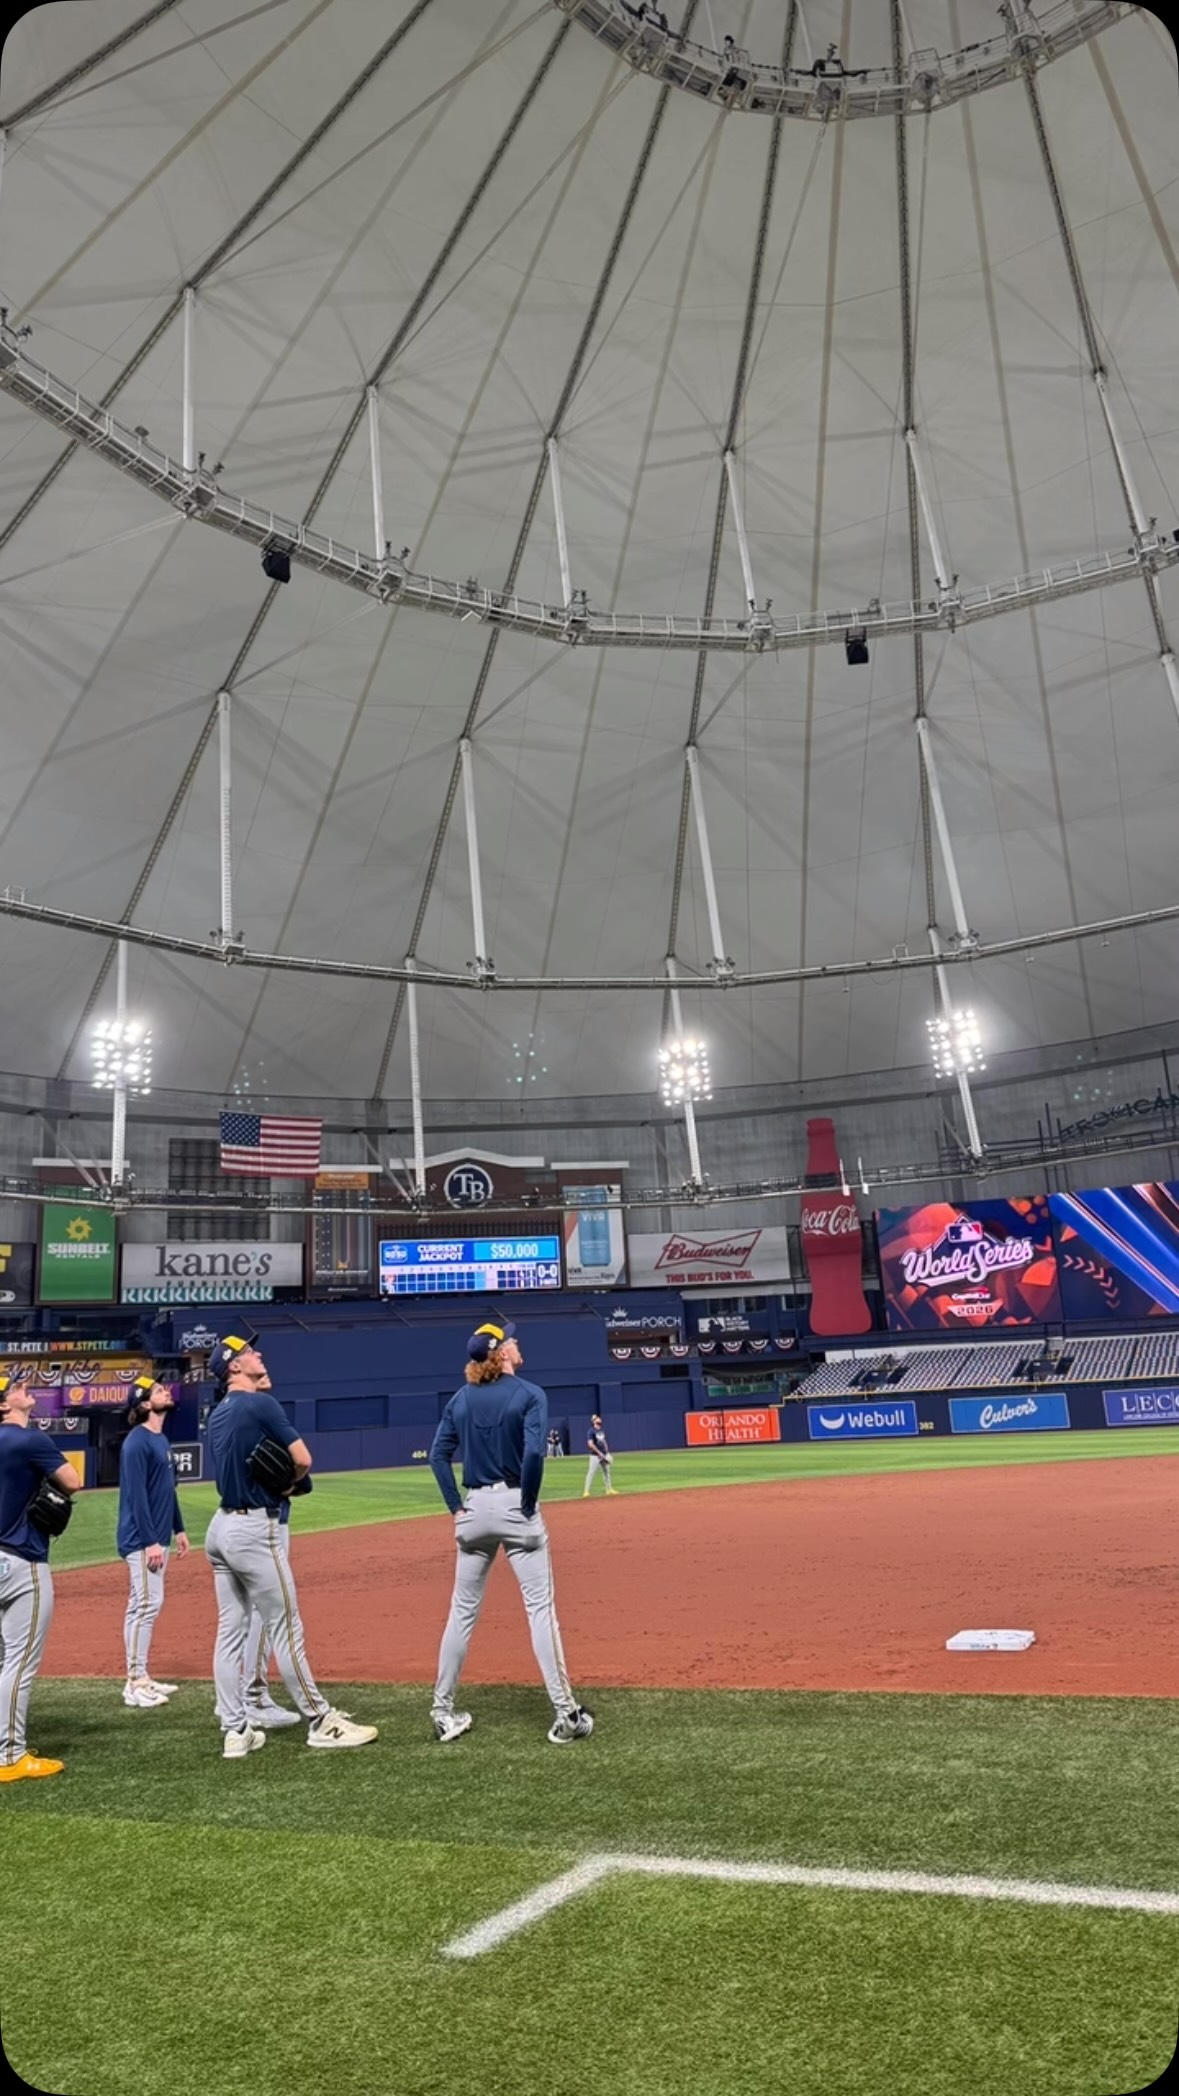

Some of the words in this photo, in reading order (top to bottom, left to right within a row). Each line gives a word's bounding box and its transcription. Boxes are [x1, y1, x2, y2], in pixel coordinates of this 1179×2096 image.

[453, 1173, 485, 1202] TB
[417, 1244, 464, 1253] CURRENT
[490, 1243, 538, 1259] $50,000
[419, 1252, 463, 1262] JACKPOT
[663, 1242, 753, 1260] Budweiser
[155, 1245, 272, 1278] kane's
[538, 1264, 558, 1278] 0-0
[666, 1274, 685, 1283] THIS
[687, 1273, 713, 1282] BUD'S
[715, 1272, 731, 1280] FOR
[957, 1304, 994, 1315] 2026
[642, 1316, 682, 1328] PORCH
[179, 1339, 220, 1349] PORCH
[89, 1386, 129, 1402] DAIQUI
[699, 1413, 767, 1427] ORLANDO
[847, 1409, 906, 1429] Webull
[979, 1398, 1038, 1429] Culver's
[708, 1427, 759, 1441] HEALTH
